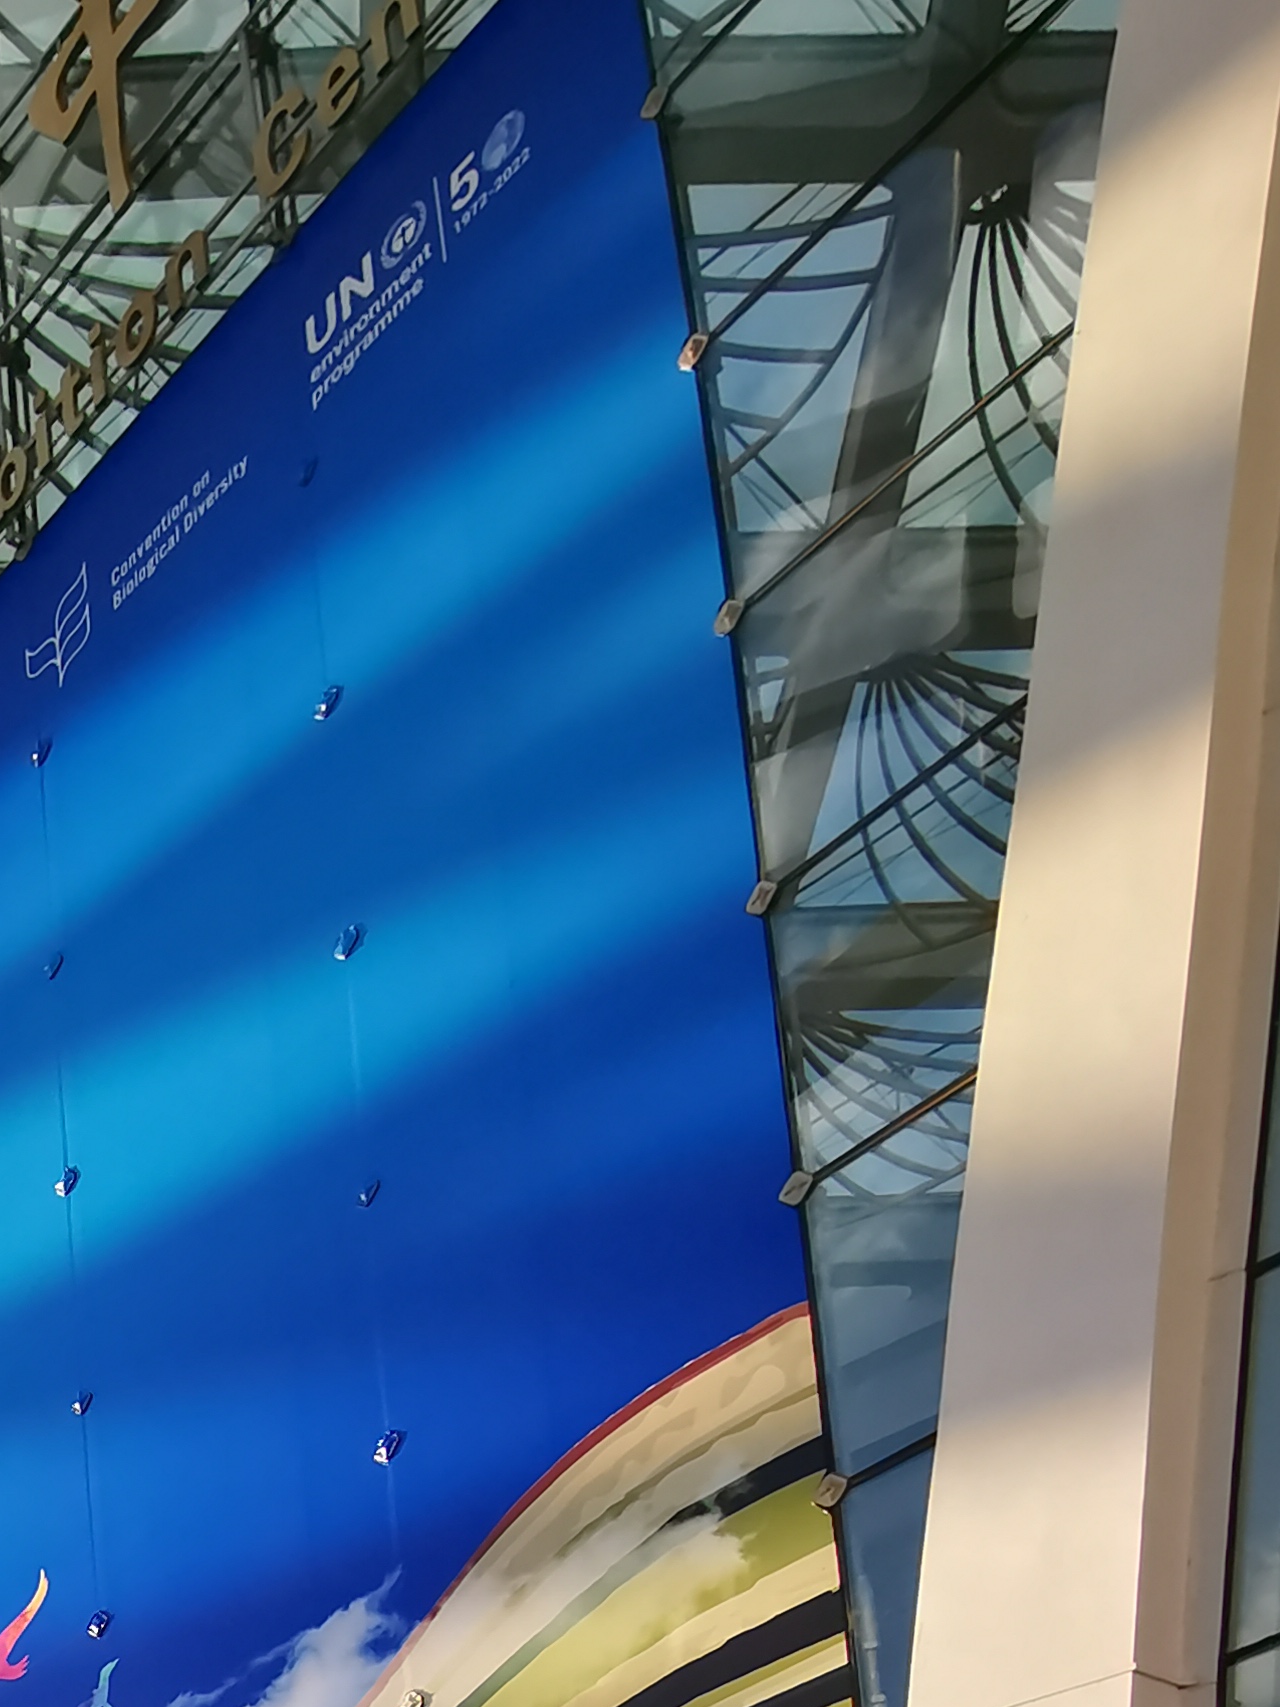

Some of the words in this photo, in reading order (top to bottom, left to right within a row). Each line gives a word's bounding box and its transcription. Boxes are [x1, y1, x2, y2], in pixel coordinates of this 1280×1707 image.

[453, 146, 531, 235] 1972-2022
[305, 250, 375, 355] UN
[310, 242, 433, 384] environment
[312, 277, 425, 411] programme
[111, 494, 188, 587] Convention
[193, 470, 210, 498] on
[112, 525, 180, 611] Biological
[184, 455, 248, 533] Diversity
